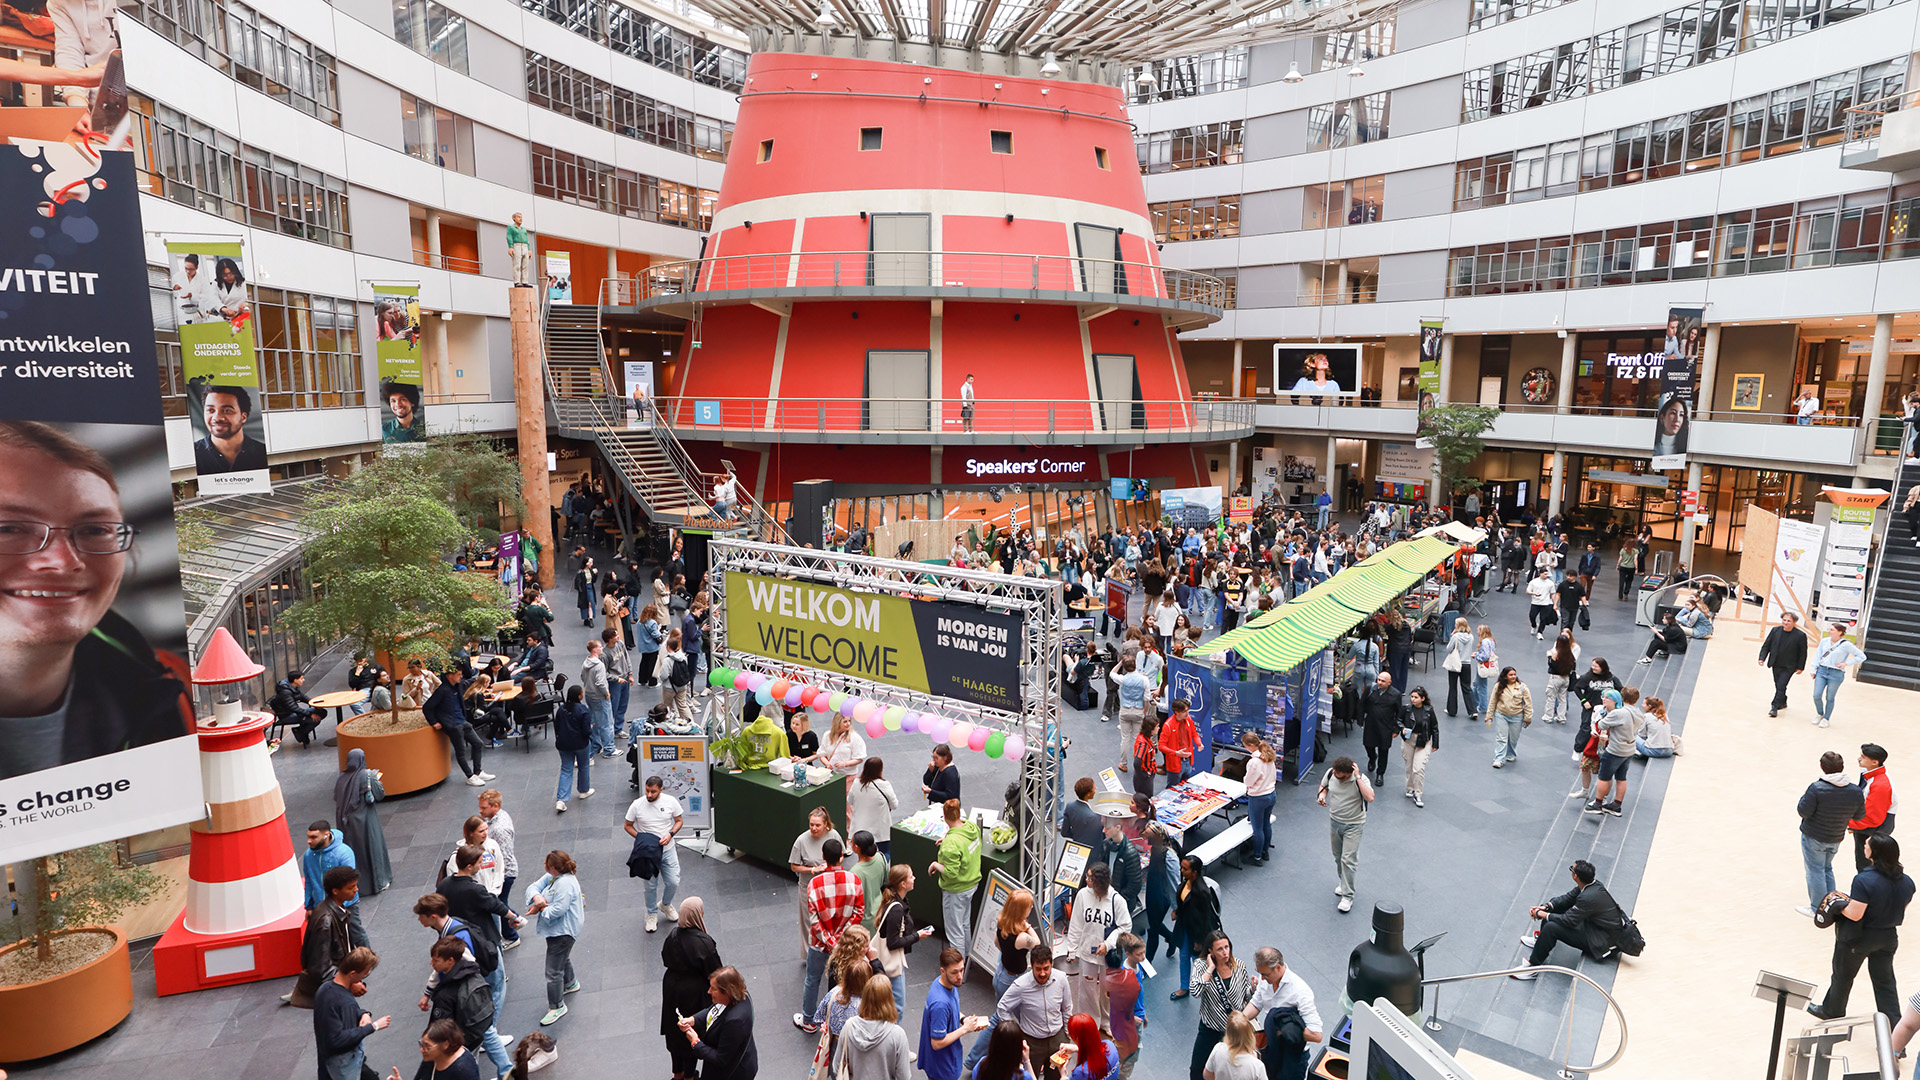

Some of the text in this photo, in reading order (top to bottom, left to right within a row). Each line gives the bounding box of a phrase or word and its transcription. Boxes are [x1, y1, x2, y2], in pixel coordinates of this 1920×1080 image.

[15, 360, 134, 378] diversiteit
[1606, 353, 1642, 366] Front
[1616, 366, 1664, 379] FZ & IT
[703, 406, 712, 420] 5
[560, 448, 579, 460] Sport
[1040, 459, 1086, 474] Corner
[682, 514, 734, 530] Photobooth
[746, 579, 880, 634] WELKOM
[938, 617, 1008, 644] MORGEN
[757, 622, 898, 680] WELCOME
[938, 634, 1007, 658] IS VAN JOU
[952, 675, 1007, 697] DE HAAGSE
[970, 691, 1016, 706] HOGESCHOOL
[17, 778, 131, 812] change
[10, 812, 38, 827] THE
[40, 802, 96, 820] WORLD.
[1084, 906, 1112, 927] GAP
